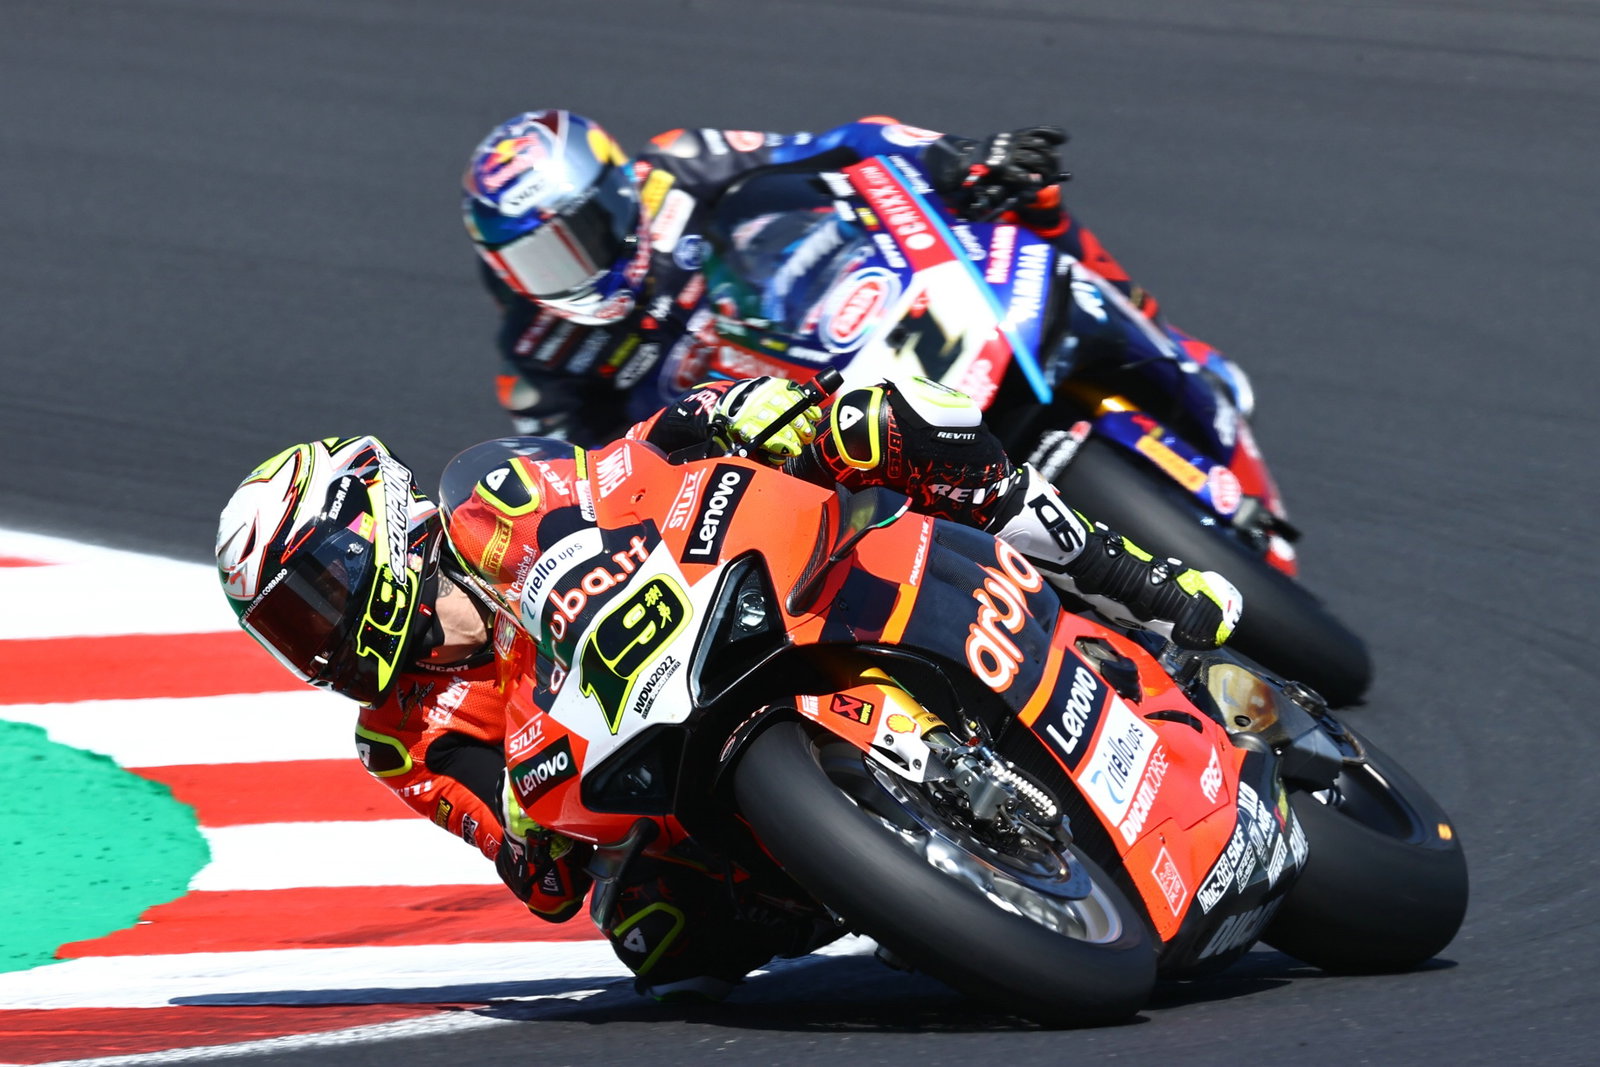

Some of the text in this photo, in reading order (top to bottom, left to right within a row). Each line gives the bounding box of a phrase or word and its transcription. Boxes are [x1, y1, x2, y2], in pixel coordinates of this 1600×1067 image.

[937, 431, 976, 440] REV'IT!
[380, 464, 411, 584] SCORPION
[669, 471, 699, 528] STULZ
[689, 471, 740, 555] Lenovo
[262, 568, 288, 596] CORRADO
[527, 542, 583, 603] riello ups
[909, 533, 928, 586] PANIGALE
[415, 660, 470, 673] DUCATI
[579, 573, 693, 735] 19
[633, 655, 676, 714] WDW2022
[1046, 666, 1097, 755] Lenovo
[508, 720, 542, 754] STULZ
[1103, 722, 1144, 789] riello ups
[516, 751, 568, 797] Lenovo
[1226, 823, 1246, 869] SKF
